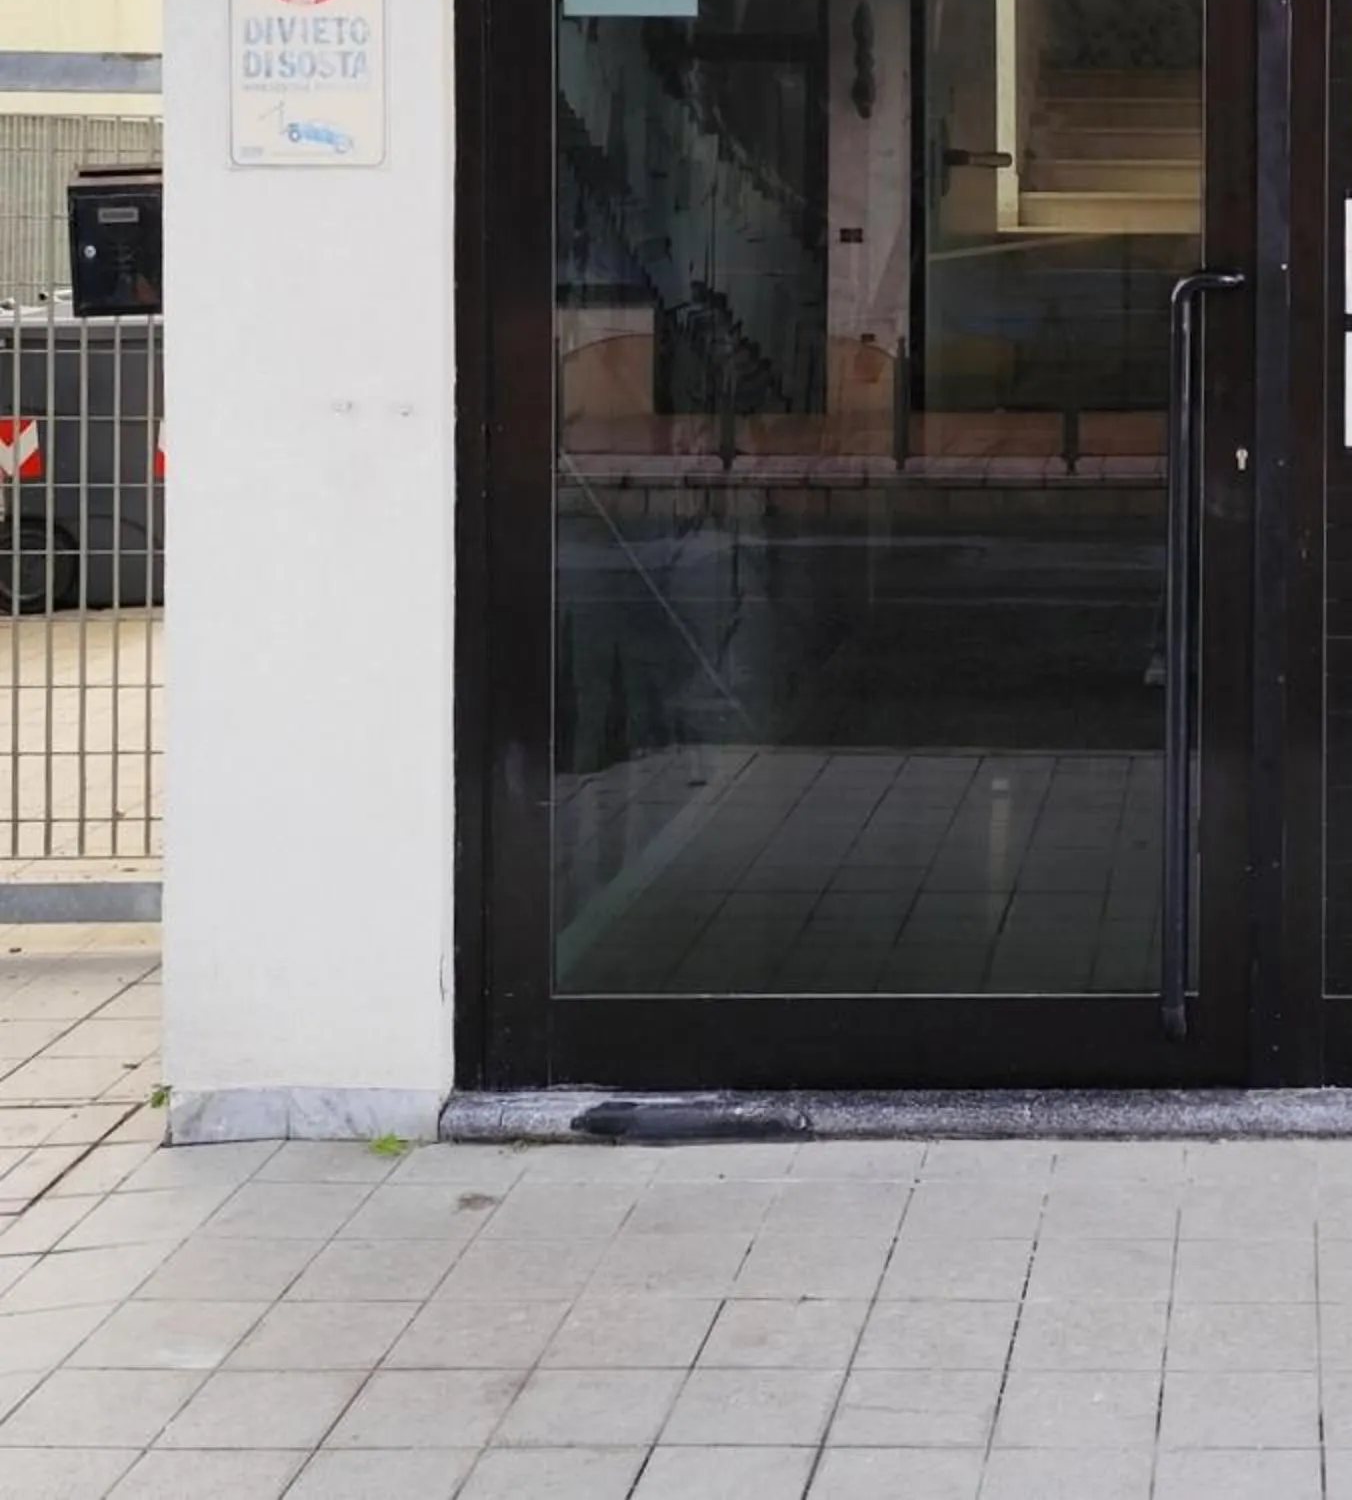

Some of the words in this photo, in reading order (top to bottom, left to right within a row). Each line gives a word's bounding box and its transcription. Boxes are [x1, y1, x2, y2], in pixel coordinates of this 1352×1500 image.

[243, 16, 370, 46] DIVIETO
[243, 50, 273, 78] DI
[278, 50, 370, 78] SOSTA
